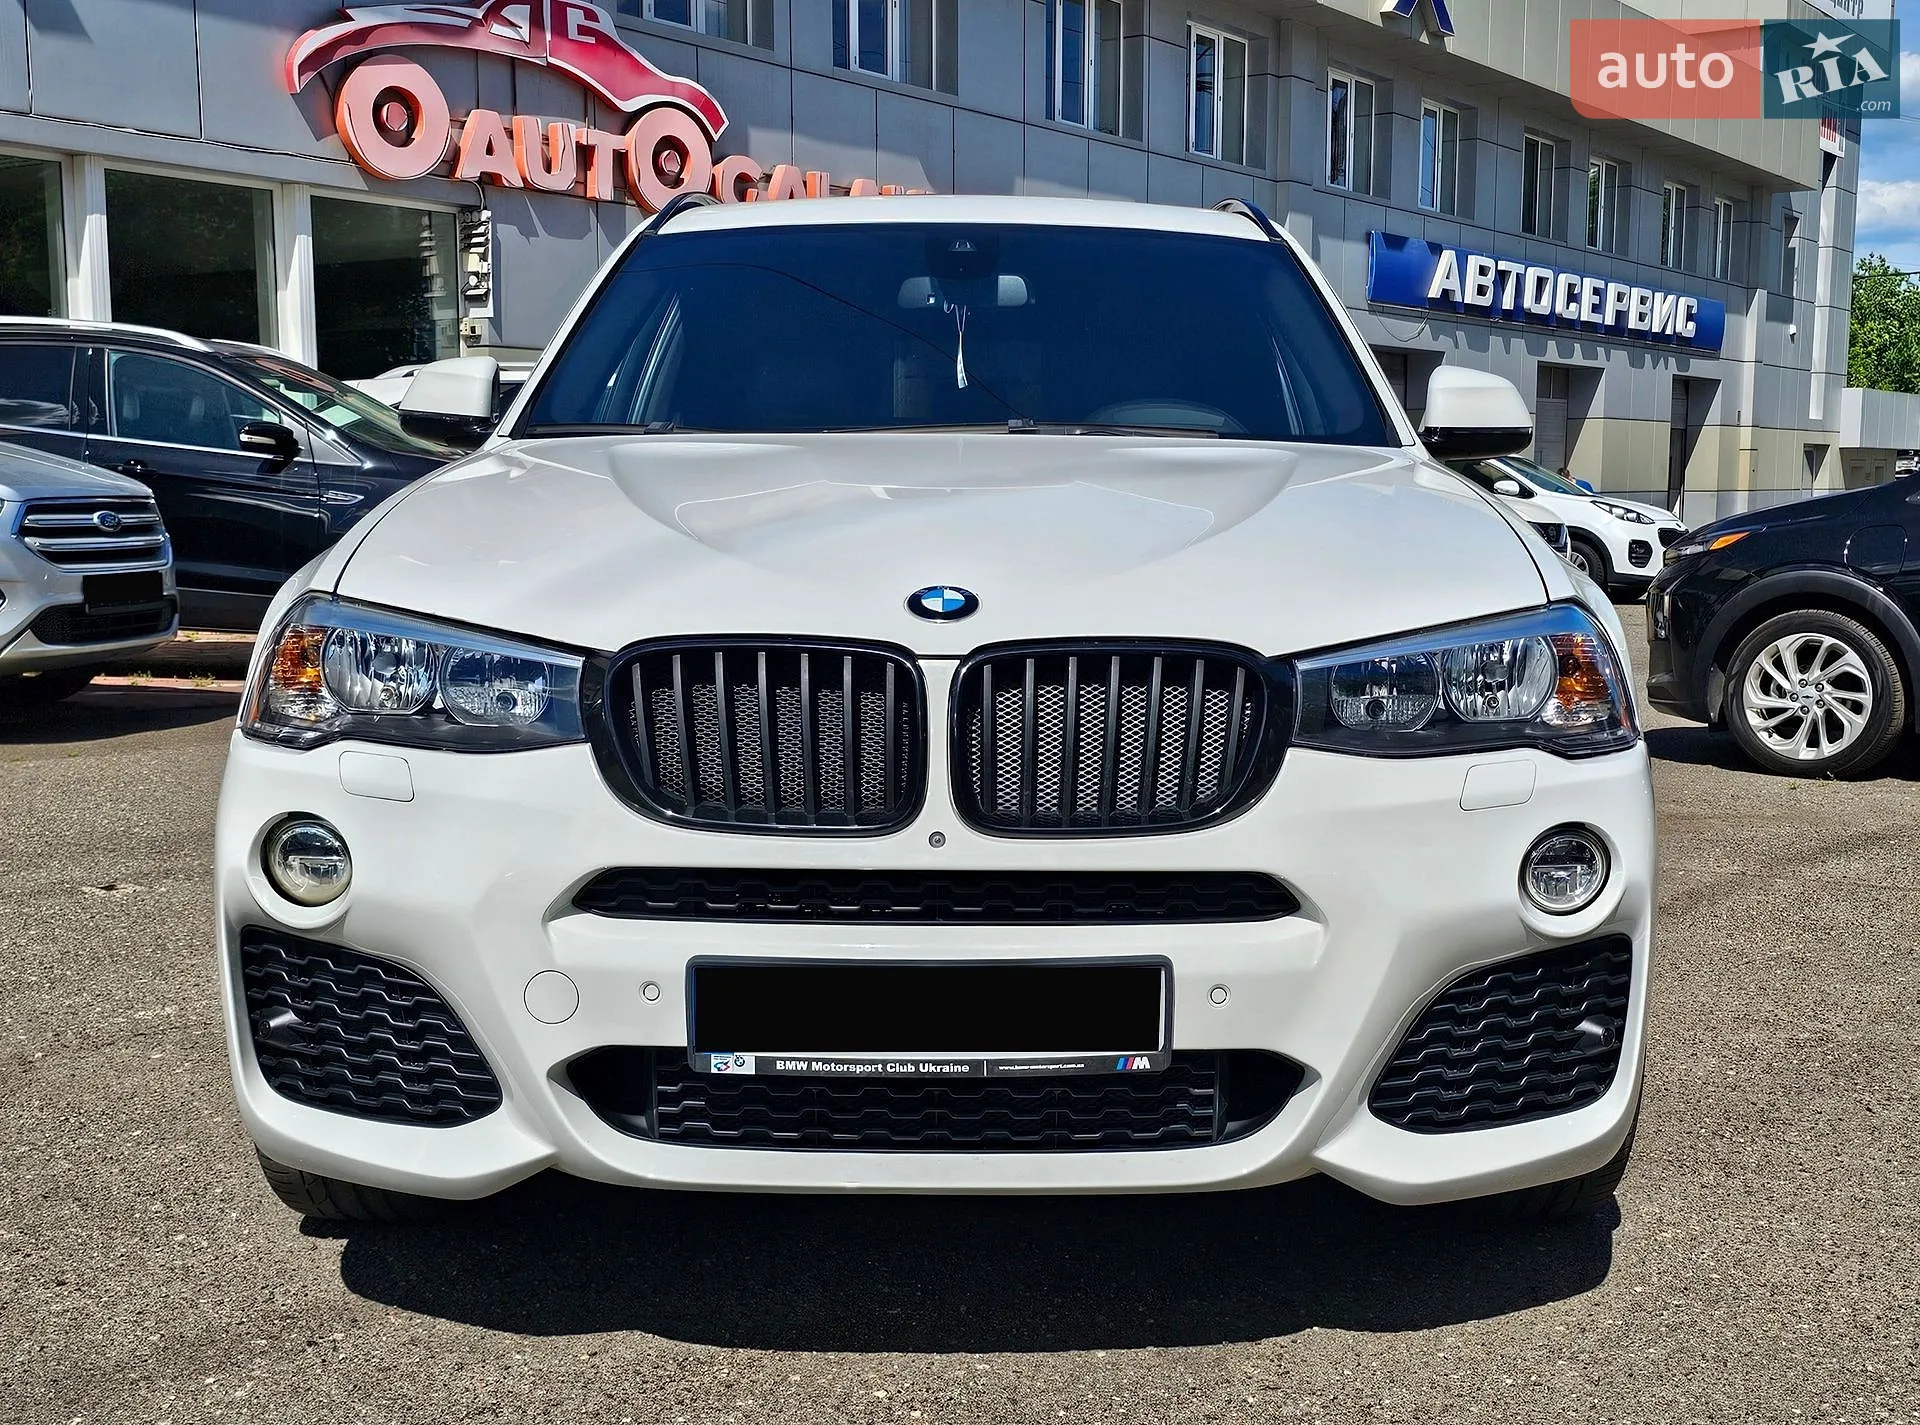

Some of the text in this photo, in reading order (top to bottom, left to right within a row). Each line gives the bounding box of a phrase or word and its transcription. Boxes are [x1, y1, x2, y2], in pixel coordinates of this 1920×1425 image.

[1428, 250, 1698, 338] АВТОСЕРВИС
[776, 1060, 970, 1074] BMW Motorsport Club Ukraine
